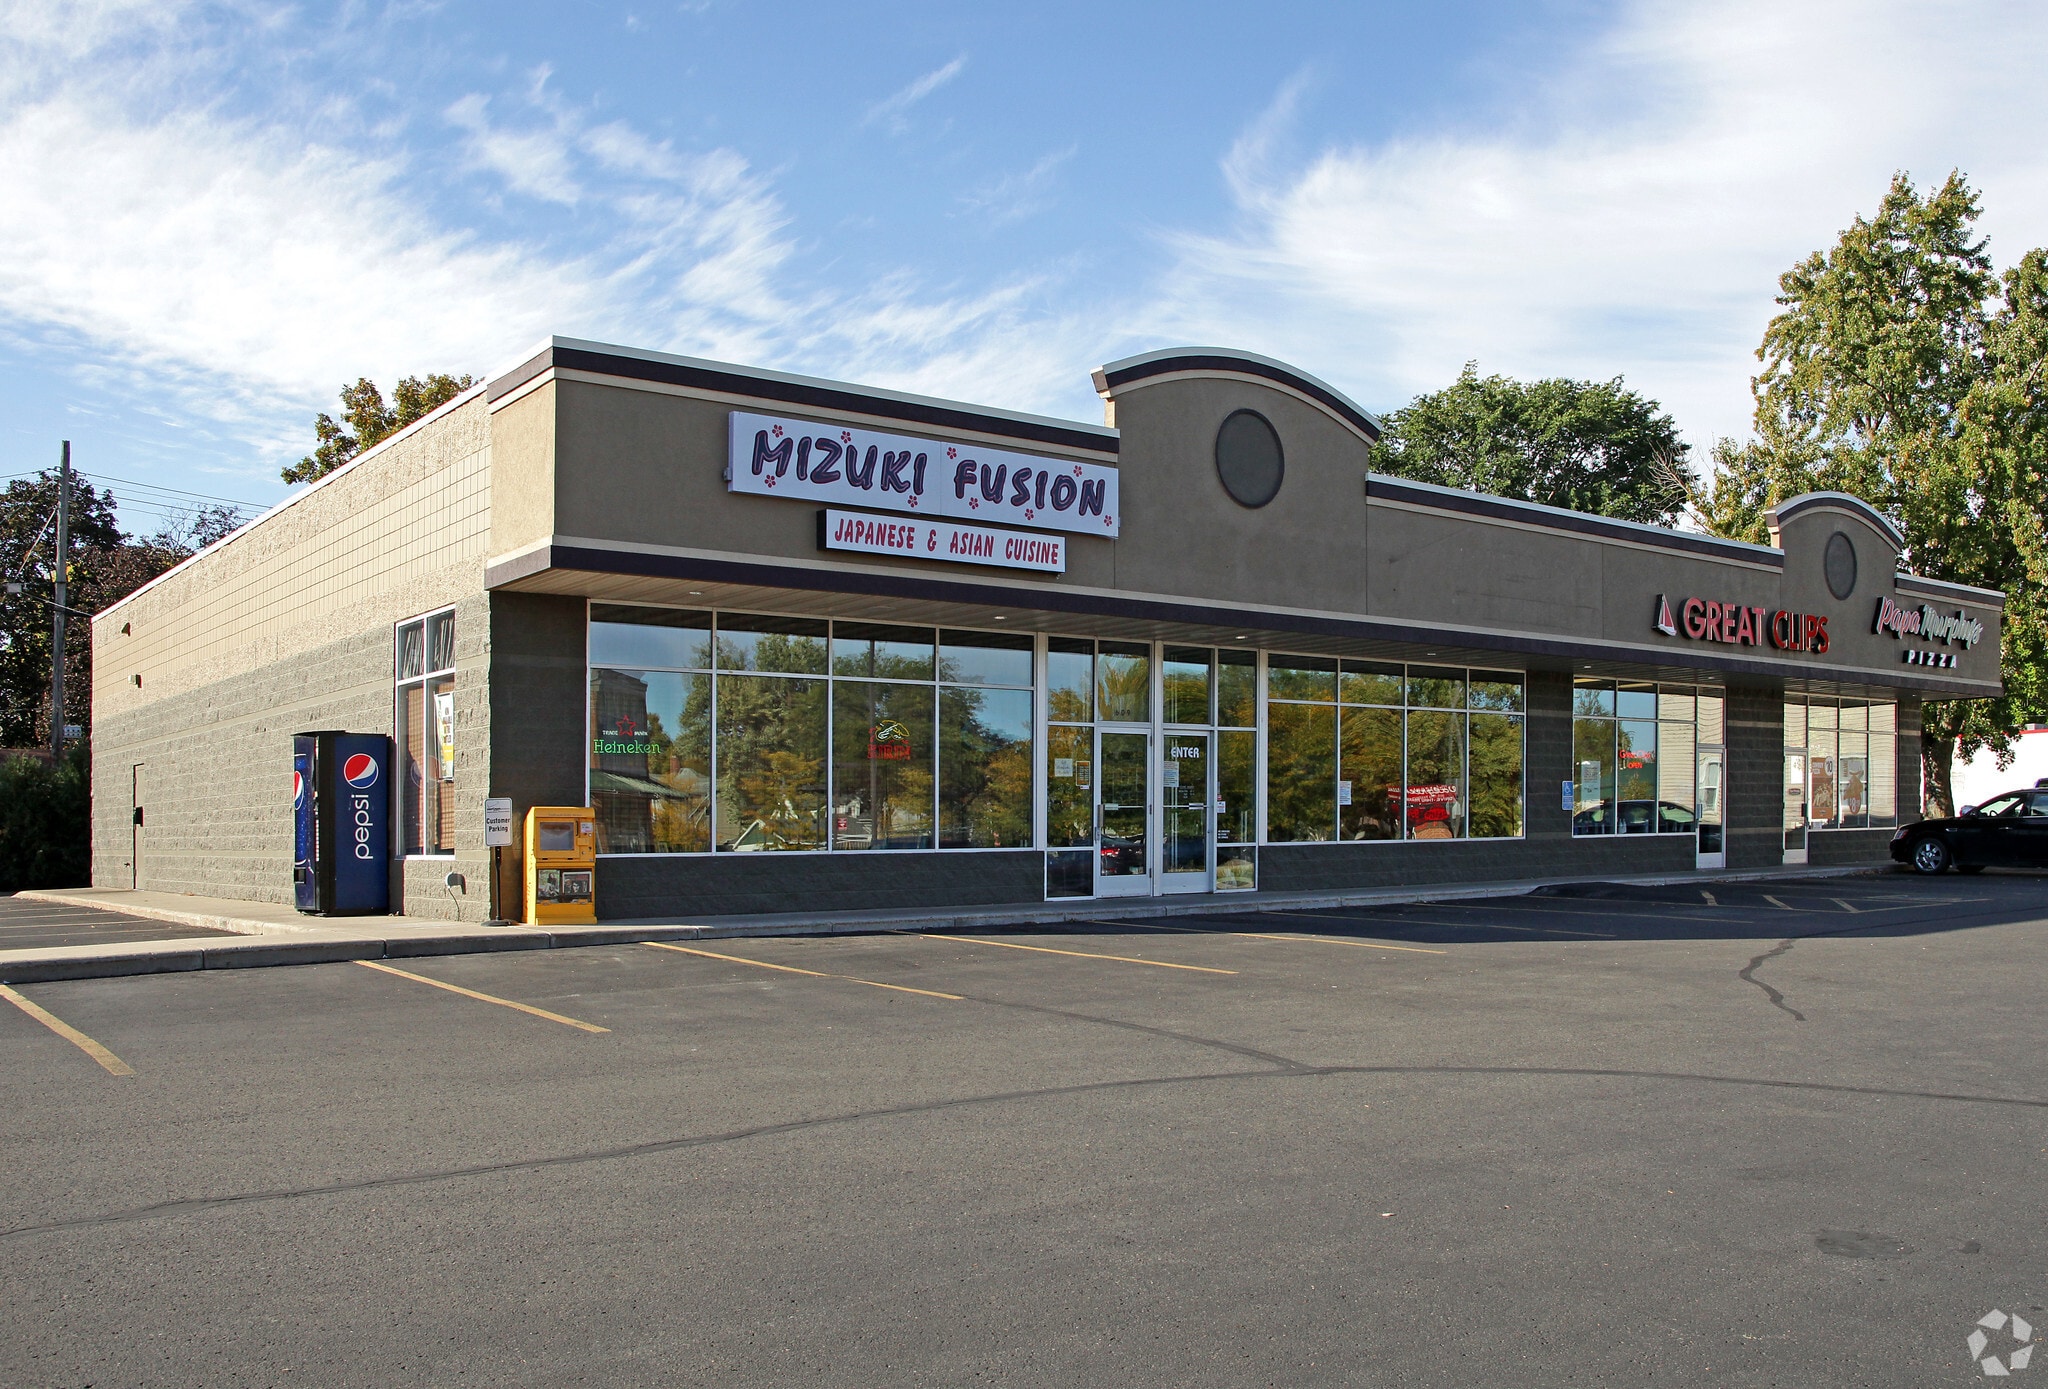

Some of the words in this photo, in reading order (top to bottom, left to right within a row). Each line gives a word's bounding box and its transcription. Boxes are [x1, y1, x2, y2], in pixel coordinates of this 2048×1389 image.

[751, 429, 928, 496] MIZUKI
[953, 459, 1105, 516] FUSION
[834, 518, 915, 549] JAPANESE
[927, 529, 937, 551] &
[949, 531, 995, 557] ASIAN
[1005, 538, 1059, 565] CUISINE
[1681, 597, 1766, 646] GREAT
[1770, 609, 1830, 653] CLIPS
[1876, 596, 1920, 640] Papa
[1906, 649, 1957, 668] PIZZA
[593, 739, 661, 754] Heineken
[1170, 746, 1200, 758] ENTER
[351, 794, 374, 860] pepsi
